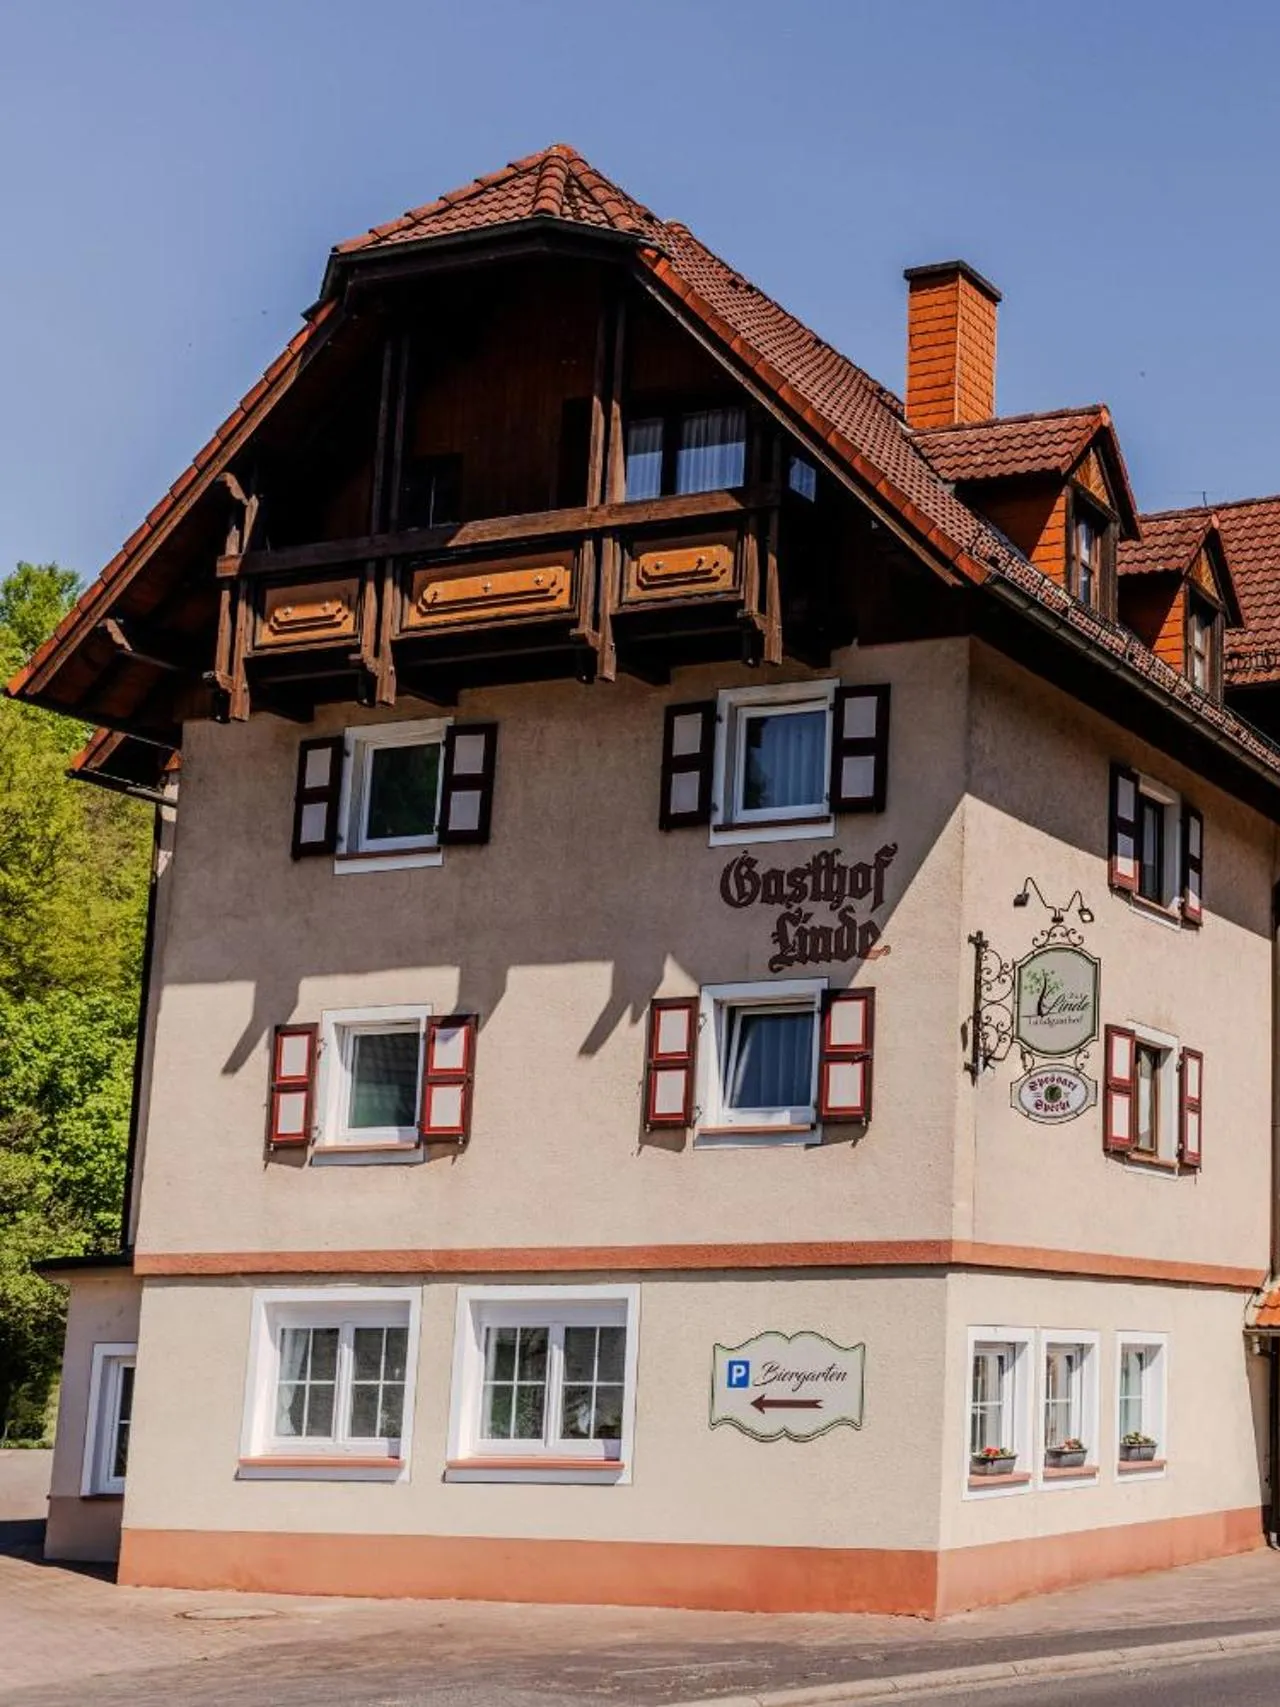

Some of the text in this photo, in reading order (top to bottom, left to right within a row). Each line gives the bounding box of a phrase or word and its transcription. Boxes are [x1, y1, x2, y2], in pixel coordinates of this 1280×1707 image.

[720, 843, 898, 912] Gasthof
[769, 905, 891, 973] Linde
[1046, 993, 1091, 1013] Linde
[1028, 1076, 1078, 1091] Spessart
[731, 1361, 848, 1392] P Biergarten
